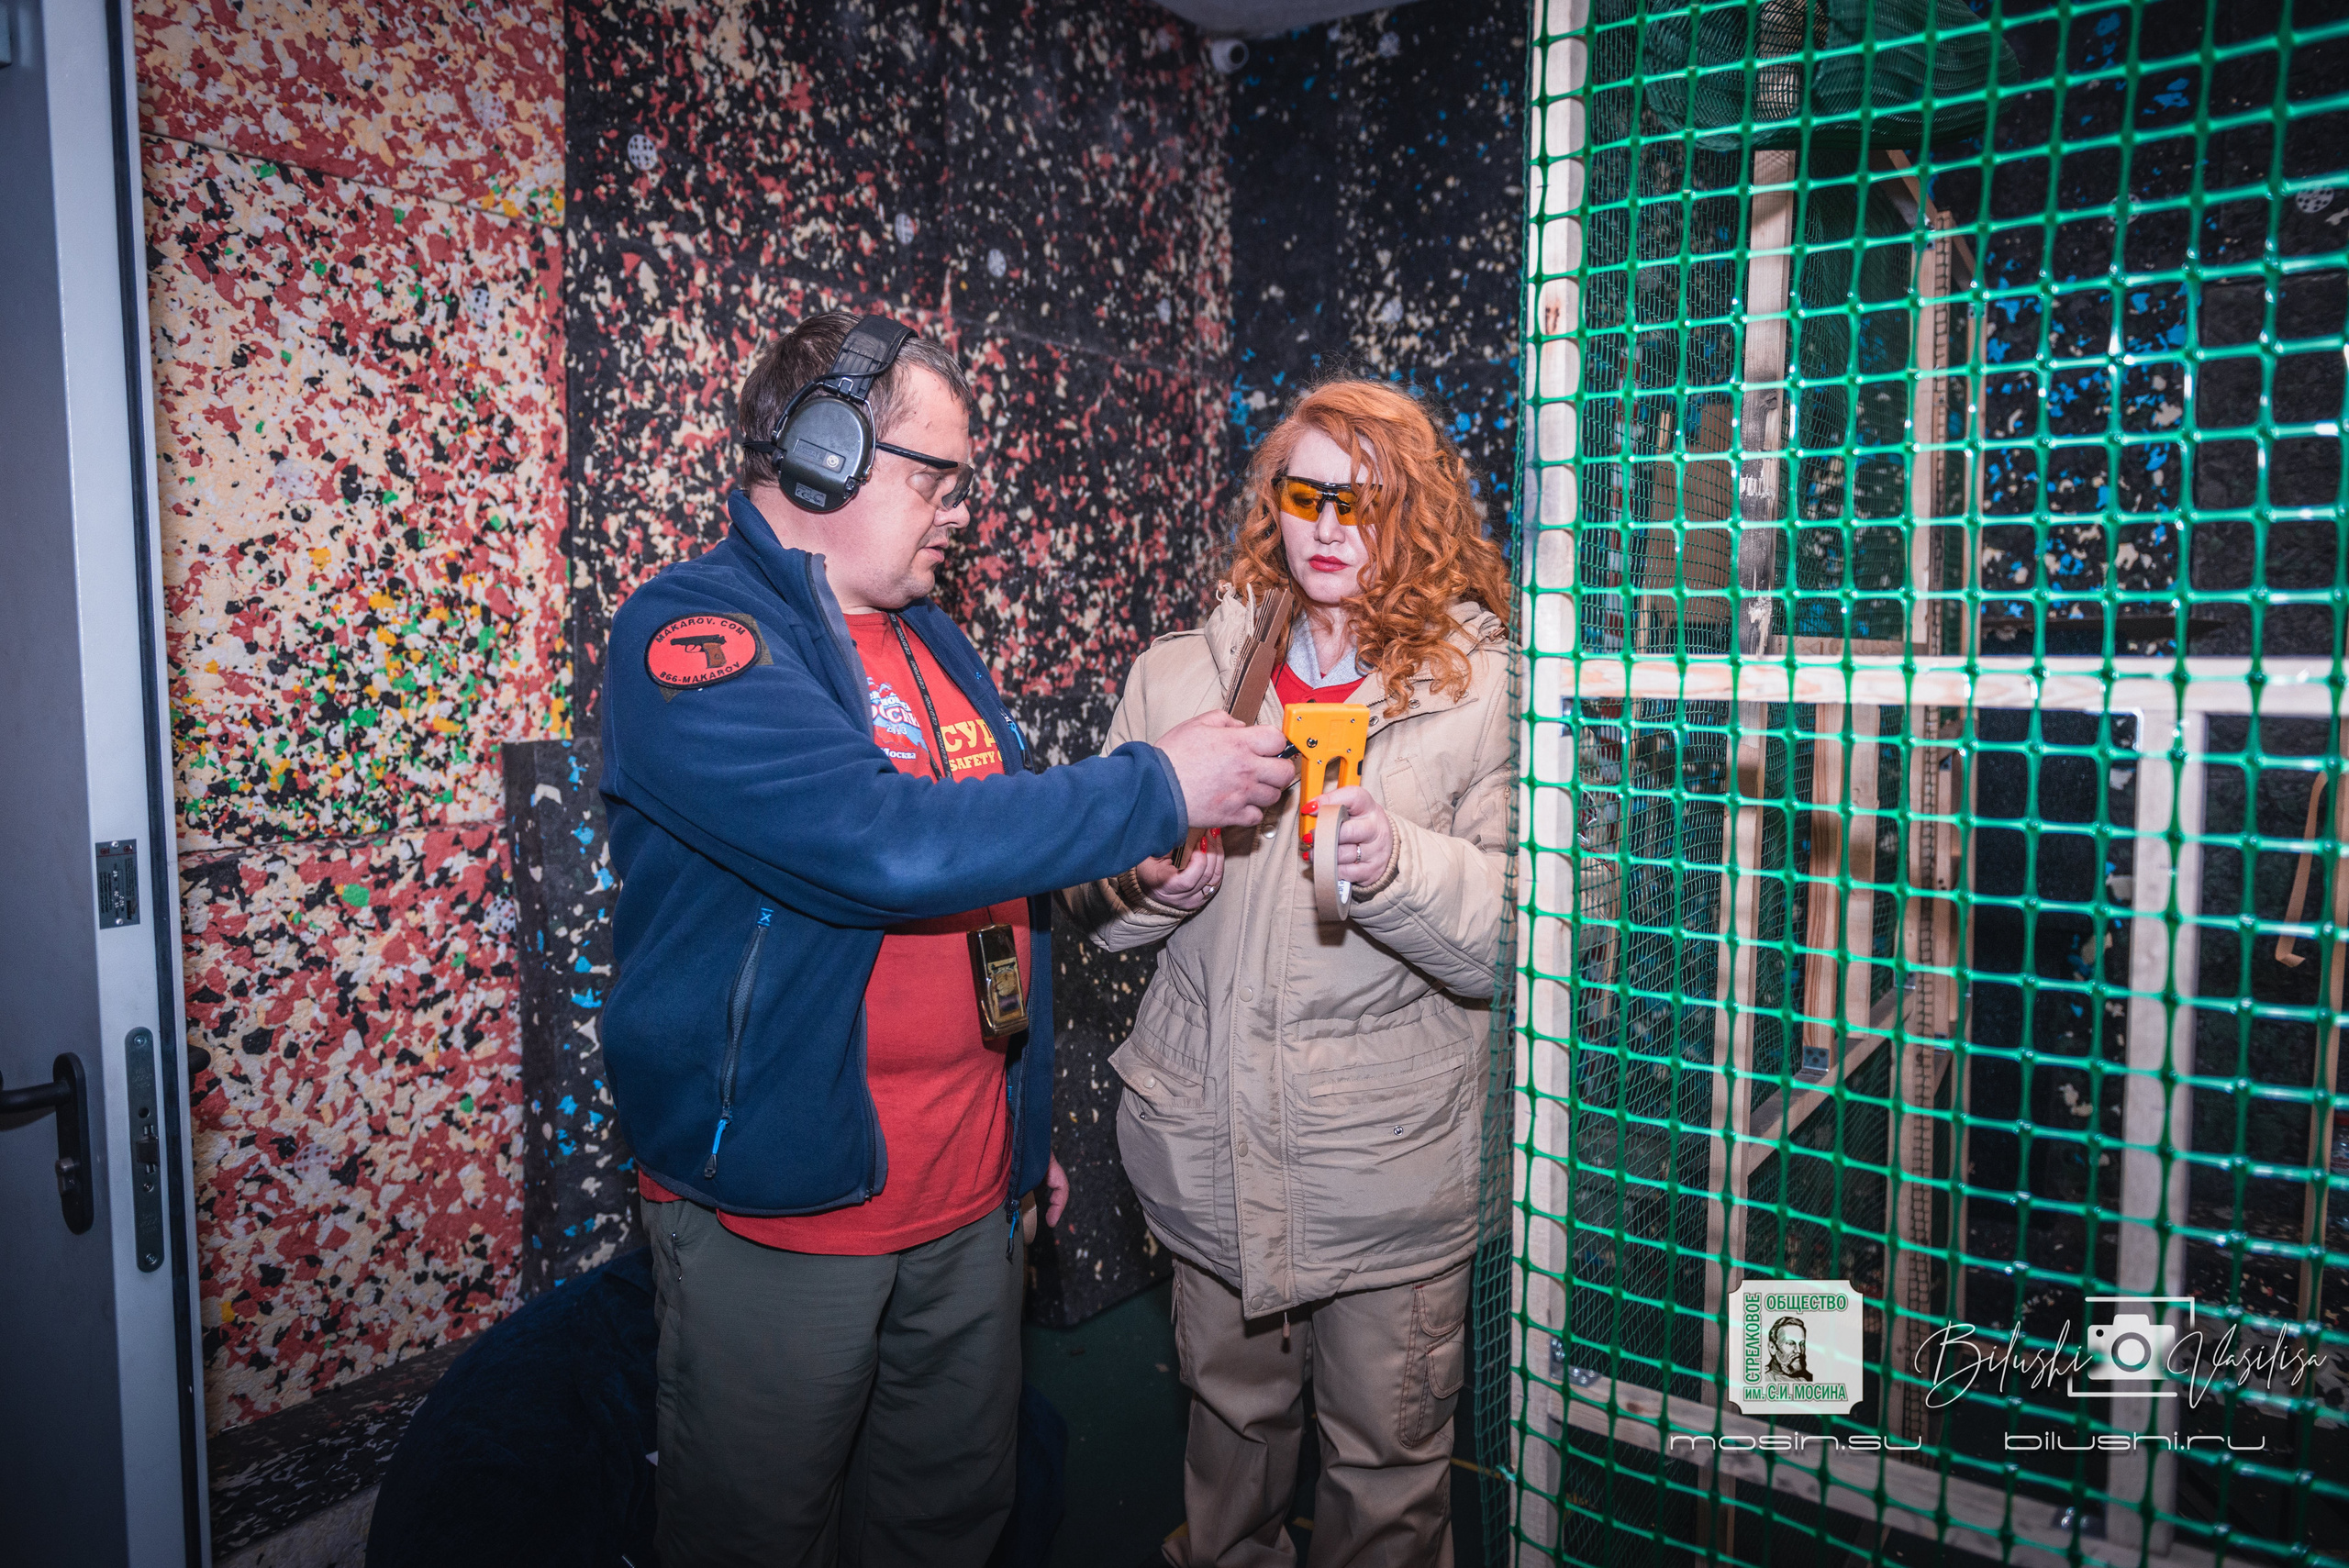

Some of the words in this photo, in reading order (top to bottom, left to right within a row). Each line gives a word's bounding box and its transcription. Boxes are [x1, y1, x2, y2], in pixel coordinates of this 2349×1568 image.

[720, 619, 746, 636] COM
[660, 661, 740, 684] 866-MAKAROV
[949, 751, 996, 772] SAFETY
